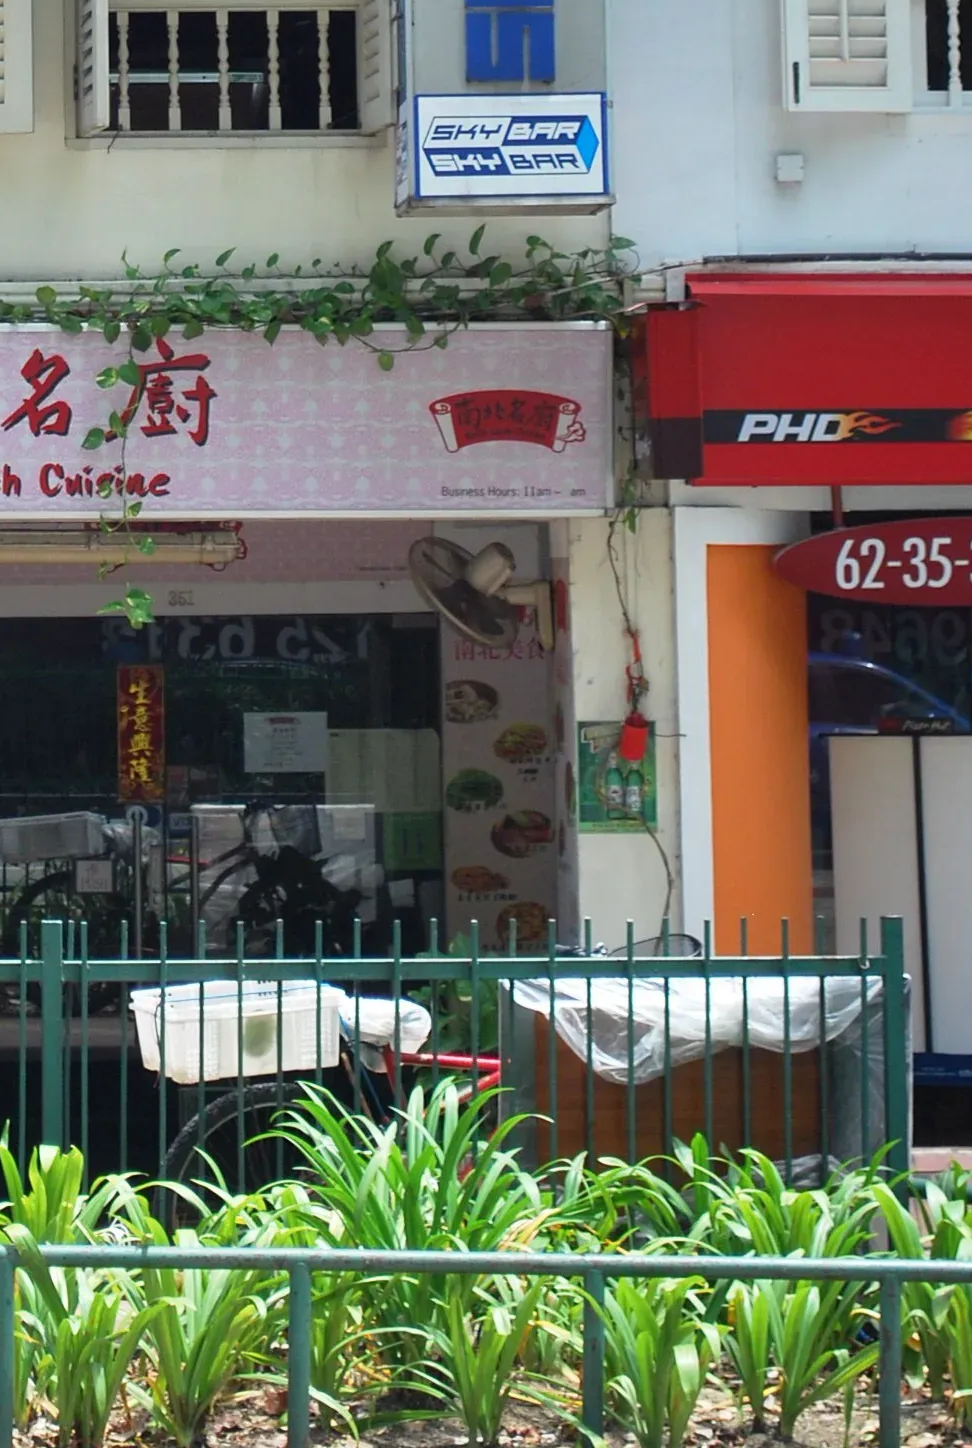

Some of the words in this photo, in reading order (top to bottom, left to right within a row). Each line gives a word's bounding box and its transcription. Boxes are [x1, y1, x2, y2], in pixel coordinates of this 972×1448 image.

[431, 124, 503, 140] SKY
[507, 122, 581, 140] BAR
[429, 154, 504, 172] SKY
[508, 153, 580, 169] BAR
[737, 413, 847, 442] PHD
[39, 463, 171, 498] Cuisine
[441, 486, 485, 498] Business
[487, 486, 520, 498] Hours:
[835, 536, 972, 590] 62-35-
